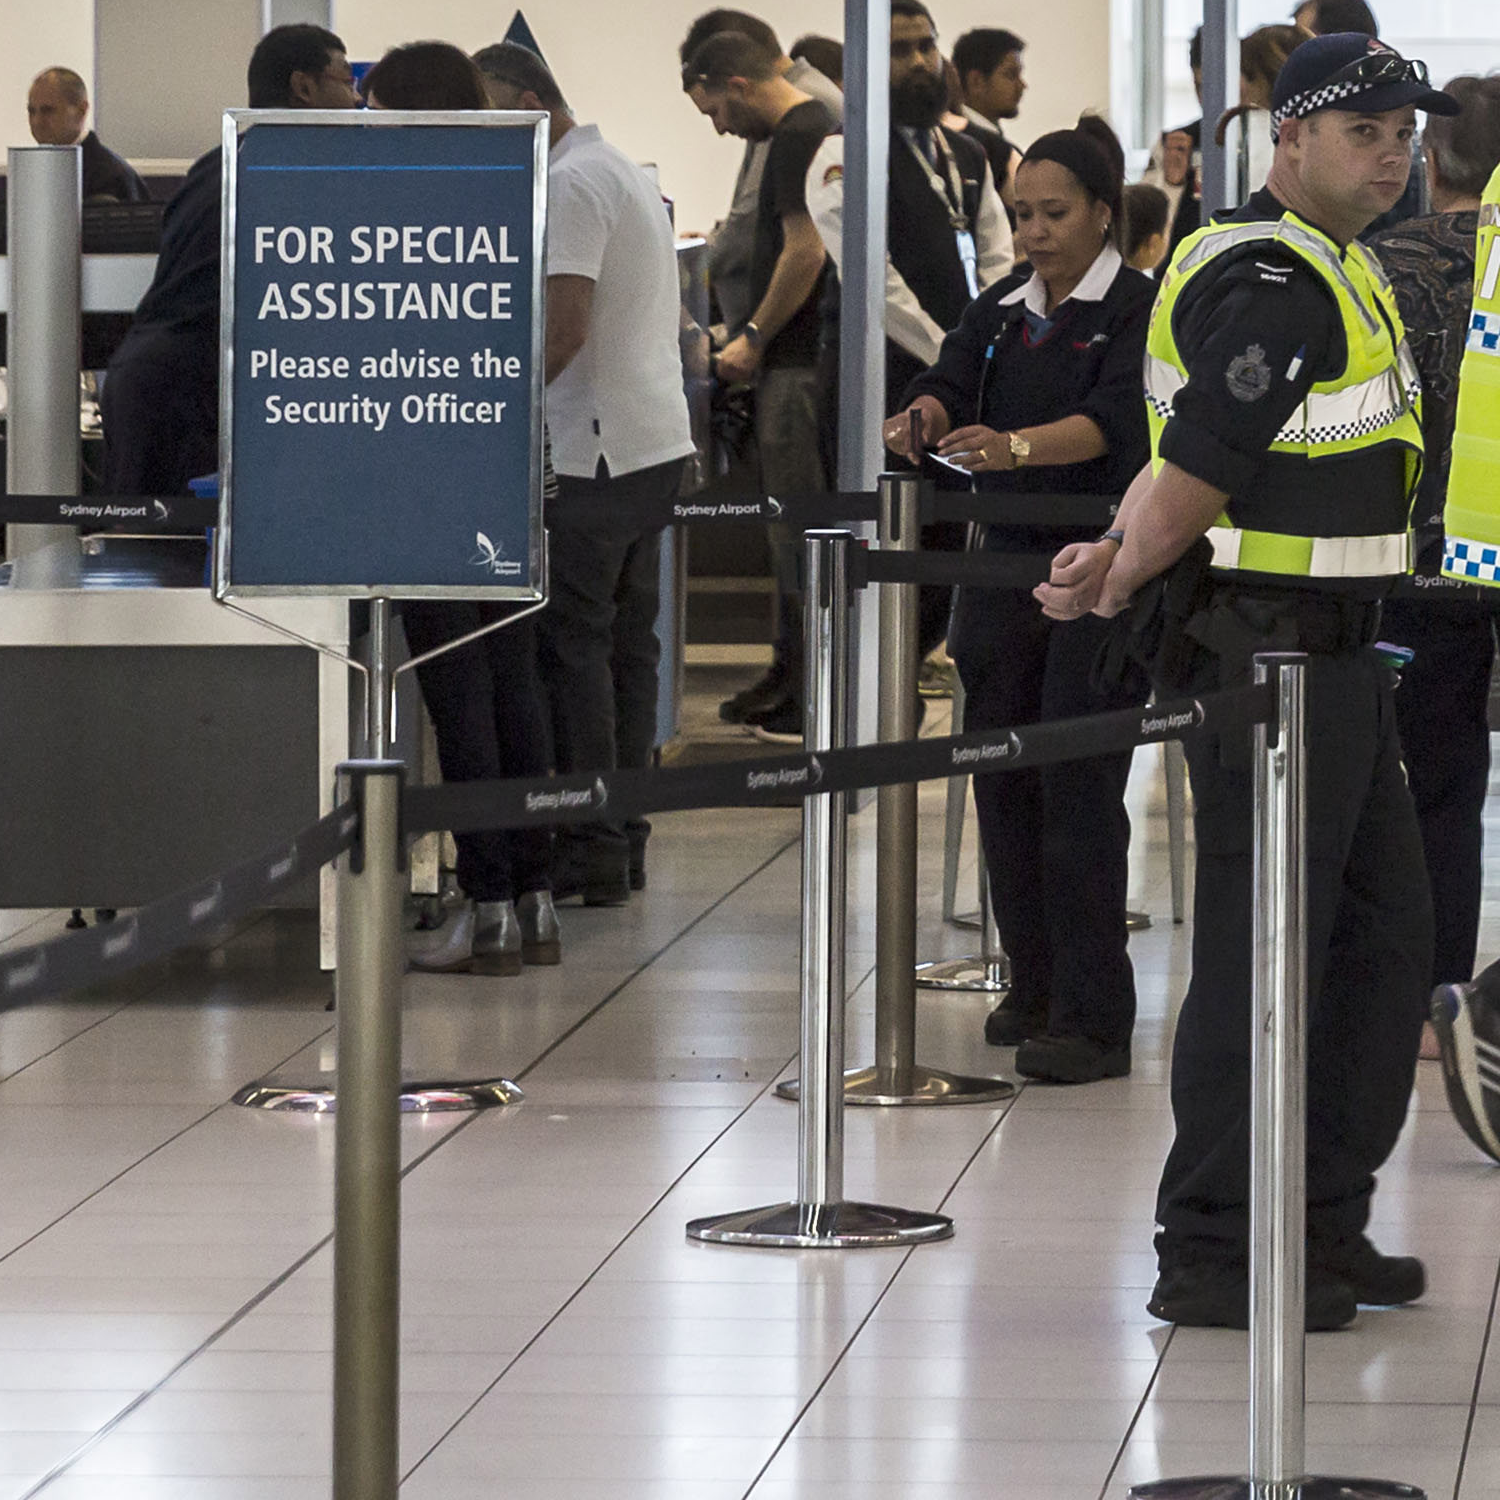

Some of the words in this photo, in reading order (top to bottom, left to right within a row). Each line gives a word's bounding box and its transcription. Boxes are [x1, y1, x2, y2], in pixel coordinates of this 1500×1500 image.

[256, 227, 334, 263] FOR
[351, 227, 518, 263] SPECIAL
[258, 283, 511, 319] ASSISTANCE
[252, 349, 349, 378] Please
[361, 349, 459, 378] advise
[471, 349, 520, 377] the
[266, 394, 390, 431] Security
[402, 393, 506, 423] Officer
[59, 503, 103, 517] Sydney
[103, 504, 147, 517] Airport
[674, 503, 718, 517] Sydney
[718, 503, 761, 516] Airport
[1141, 717, 1168, 735] Sydney
[1168, 711, 1193, 728] Airport
[952, 747, 980, 765] Sydney
[980, 743, 1008, 759] Airport
[747, 770, 777, 789] Sydney
[777, 767, 808, 785] Airport
